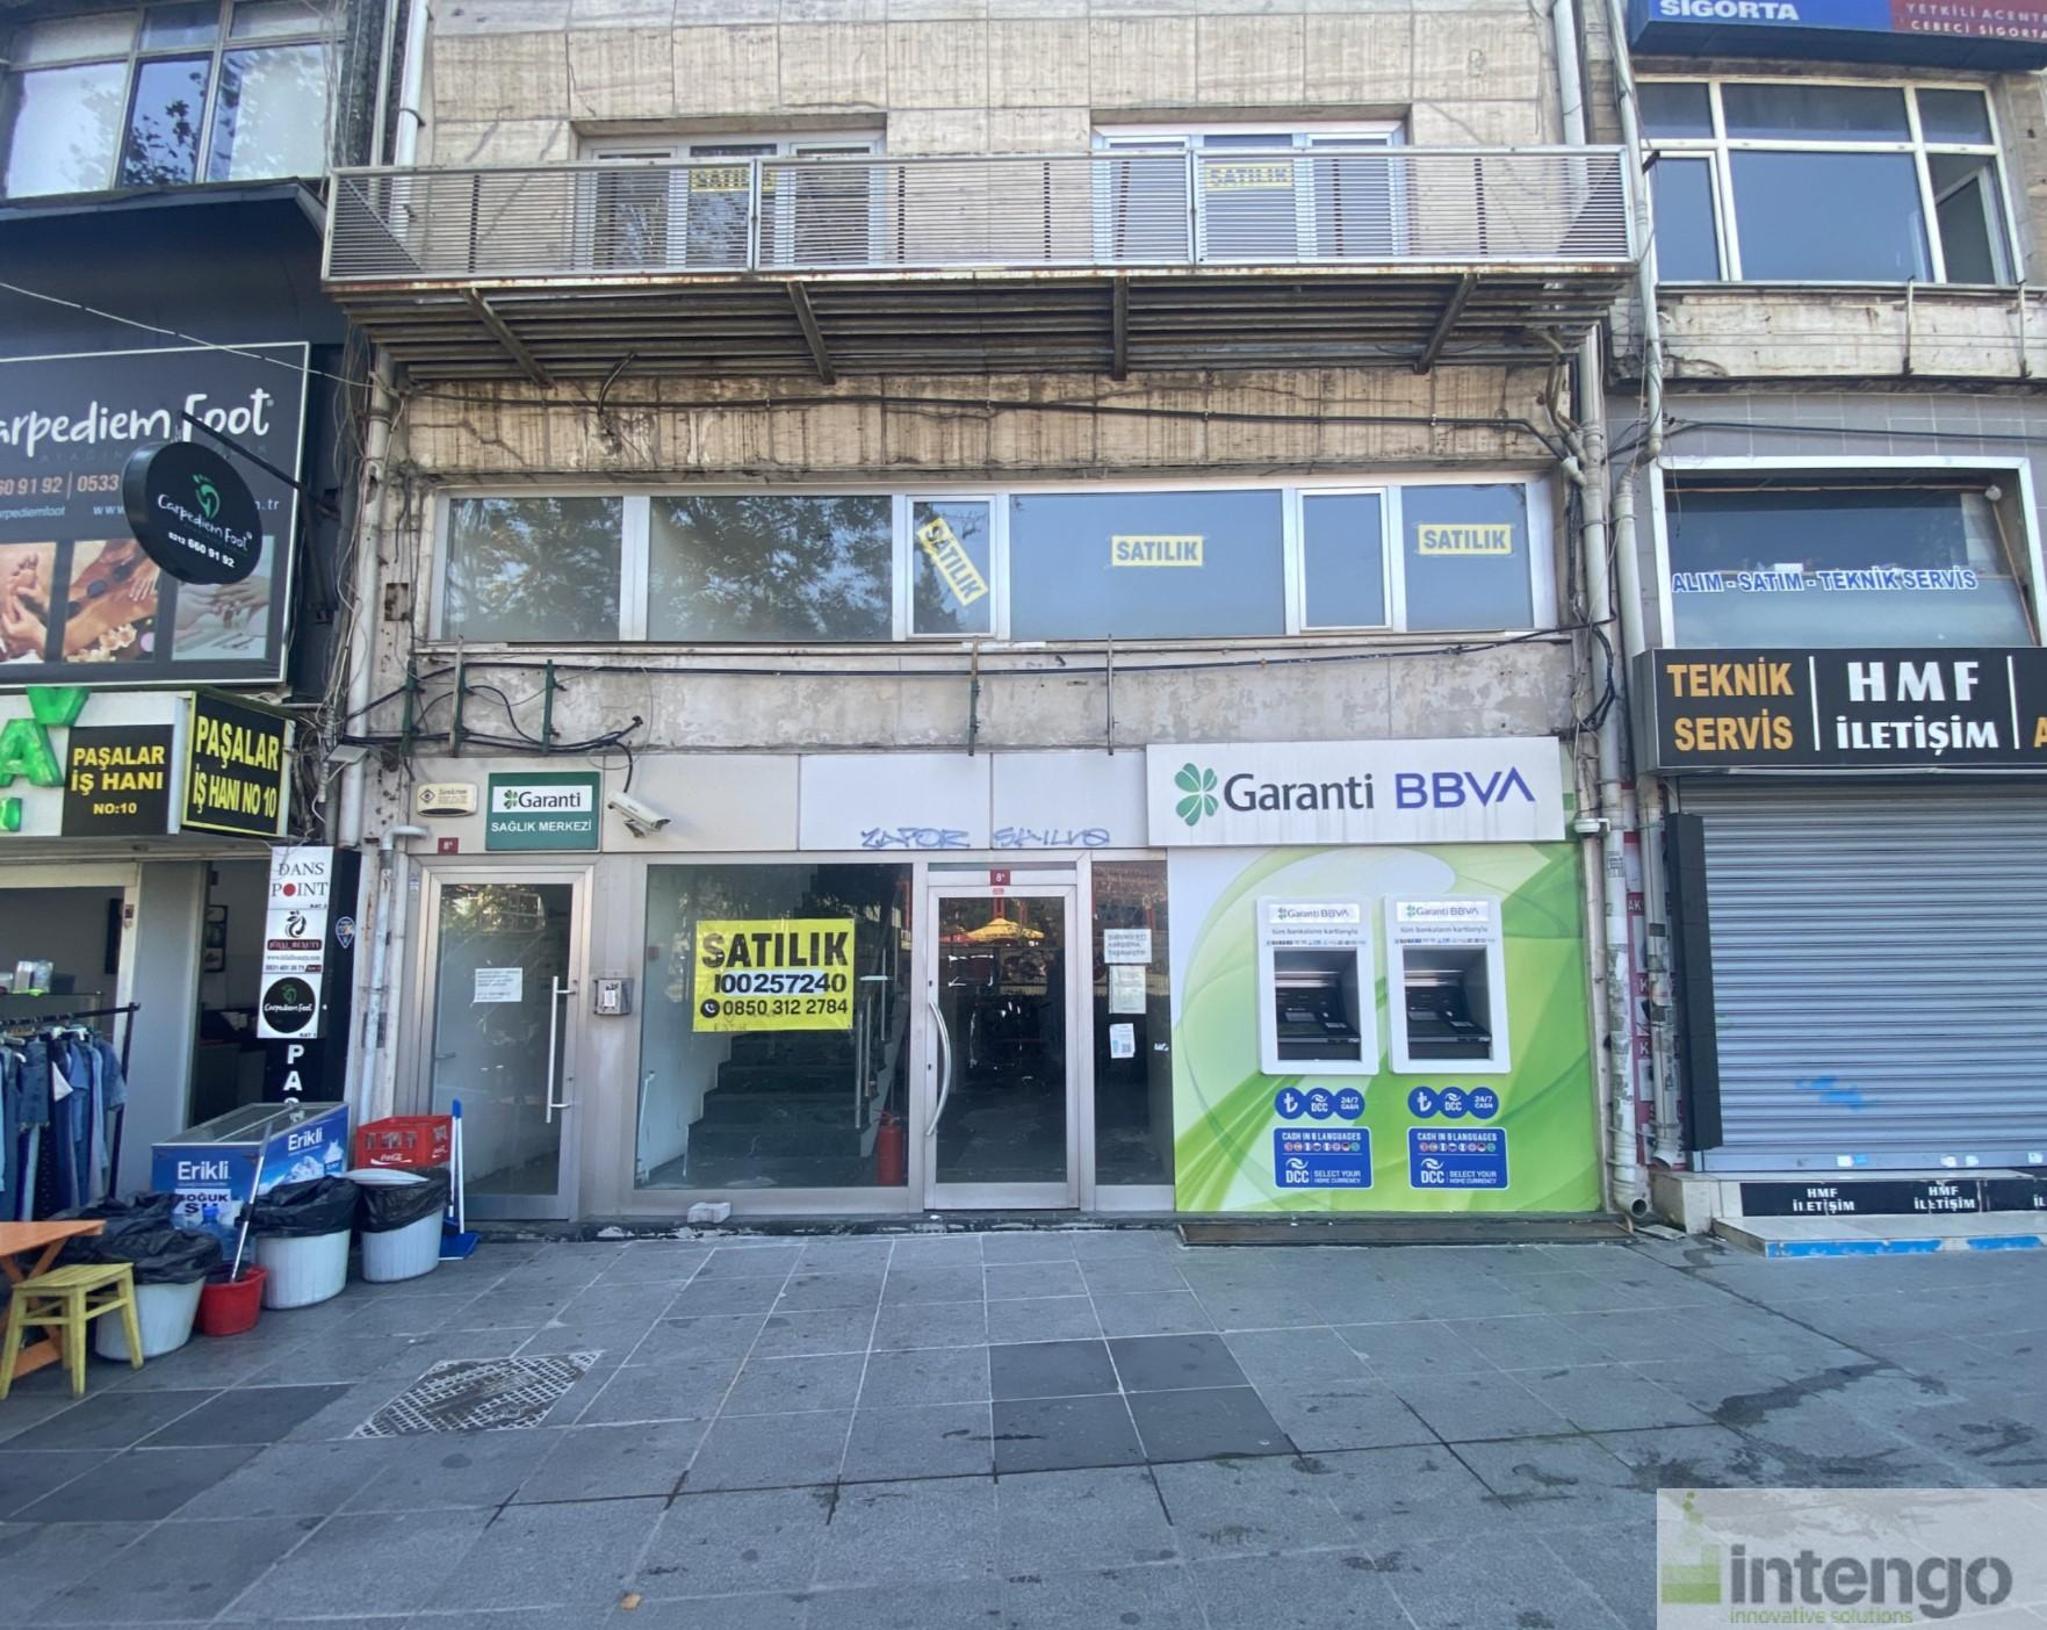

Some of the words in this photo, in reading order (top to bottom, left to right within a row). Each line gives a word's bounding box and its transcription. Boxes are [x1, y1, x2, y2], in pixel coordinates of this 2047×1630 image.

[18, 477, 37, 495] 91
[42, 476, 63, 494] 92
[77, 474, 120, 493] 0533
[1423, 529, 1507, 550] SATILIK
[1116, 541, 1198, 562] SATILIK
[925, 526, 982, 599] SATILIK
[1671, 571, 1724, 592] ALIM
[1738, 571, 1802, 592] SATIM
[1816, 566, 1899, 590] TEKNİK
[1902, 565, 1978, 590] SERVİS
[1667, 657, 1794, 698] TEKNİK
[1848, 661, 1979, 702] HMF
[1674, 709, 1794, 752] SERVİS
[1836, 715, 1999, 756] İLETİŞİM
[196, 715, 280, 772] PAŞALAR
[73, 746, 165, 770] PAŞALAR
[71, 769, 94, 796] İŞ
[102, 772, 163, 790] HANI
[193, 763, 206, 813] İŞ
[209, 775, 240, 805] HANI
[242, 782, 261, 815] NO
[263, 787, 277, 818] 10
[1223, 772, 1374, 812] Garanti
[1394, 767, 1536, 810] BBVA
[93, 803, 137, 815] NO:10
[518, 791, 581, 808] Garanti
[491, 820, 536, 833] SAĞLIK
[538, 819, 592, 832] MERKEZİ
[278, 863, 325, 876] DANS
[1287, 909, 1319, 918] Garanti
[1416, 907, 1448, 916] Garanti
[702, 932, 849, 968] SATILIK
[723, 1000, 767, 1015] 0850
[773, 1000, 800, 1014] 312
[806, 999, 848, 1014] 2784
[288, 1128, 323, 1151] Erikli
[178, 1161, 229, 1180] Erikli
[1286, 1170, 1309, 1183] DCC
[1421, 1170, 1444, 1183] DCC
[1807, 1188, 1838, 1198] HMF
[1928, 1186, 1959, 1196] HMF
